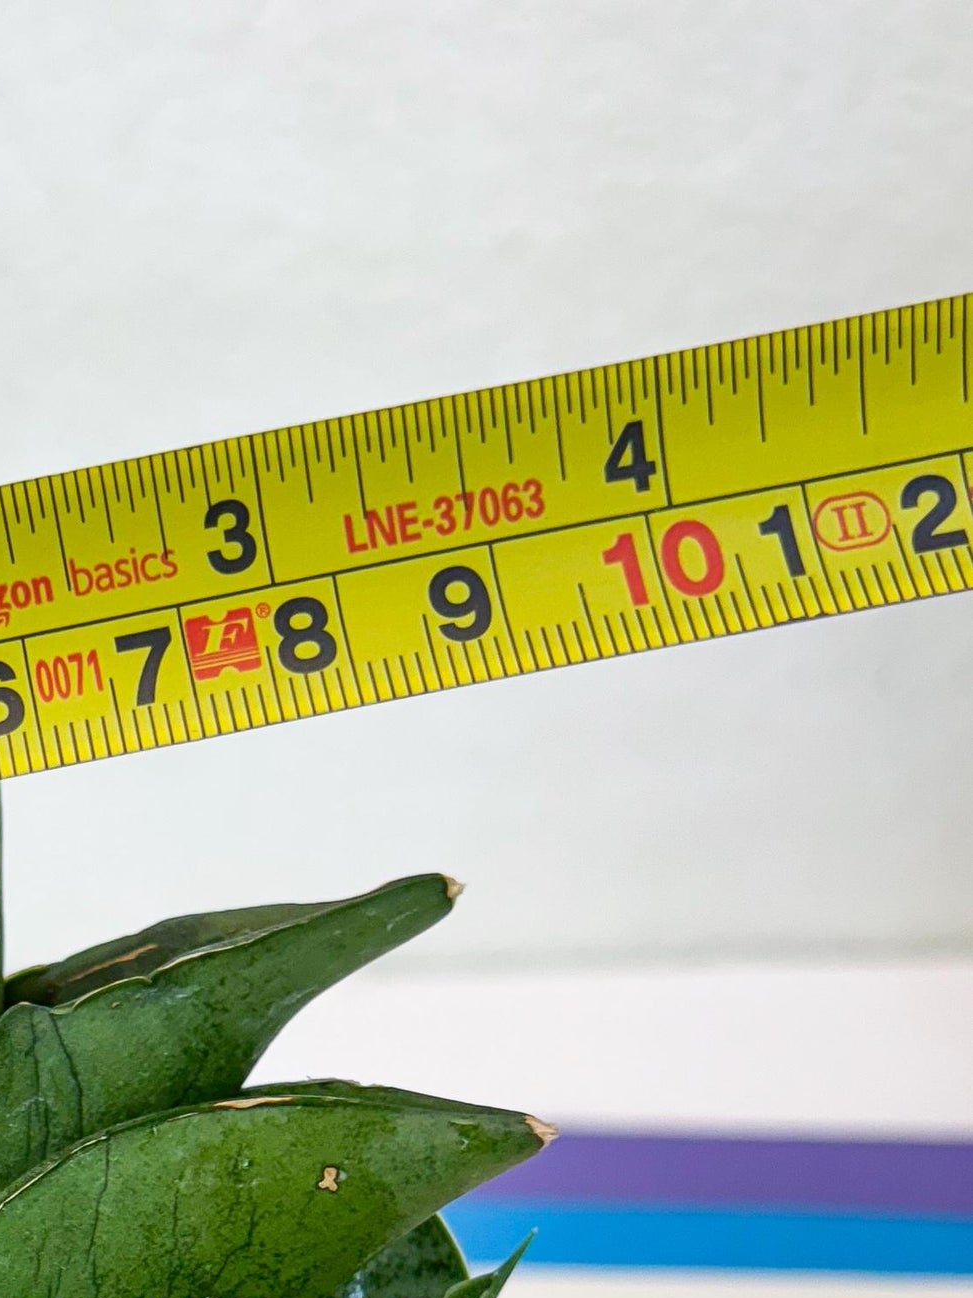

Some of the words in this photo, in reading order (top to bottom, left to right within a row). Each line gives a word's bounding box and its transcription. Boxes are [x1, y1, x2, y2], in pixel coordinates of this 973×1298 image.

[604, 421, 656, 491] 4
[203, 500, 257, 575] 3
[344, 479, 545, 553] LNE-37063
[759, 505, 806, 577] 1
[901, 475, 969, 553] 2
[69, 549, 178, 597] basics
[602, 520, 725, 605] 10
[274, 597, 337, 673] 8
[428, 566, 492, 641] 9
[35, 650, 103, 702] 0071
[115, 627, 172, 706] 7
